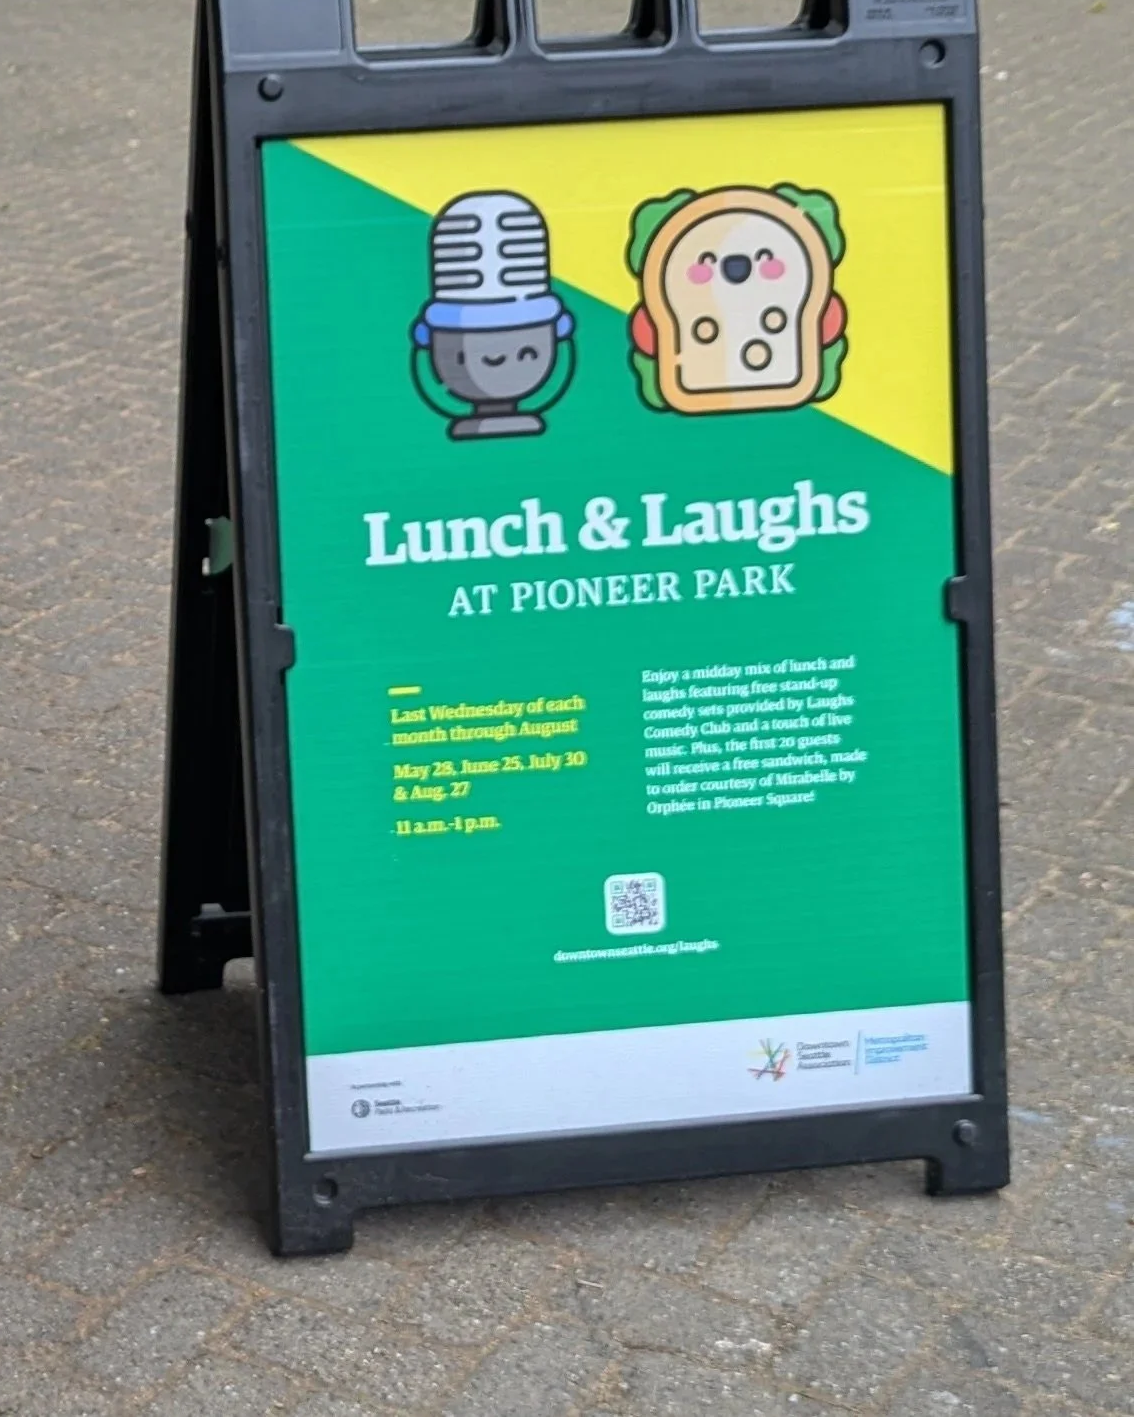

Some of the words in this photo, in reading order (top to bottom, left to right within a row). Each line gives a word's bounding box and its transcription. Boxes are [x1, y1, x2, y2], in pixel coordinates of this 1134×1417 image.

[363, 499, 567, 566] Lunch
[578, 496, 631, 551] &
[641, 479, 871, 553] Laughs
[448, 584, 499, 617] AT
[511, 572, 683, 613] PIONEER
[693, 562, 797, 600] PARK
[642, 669, 679, 685] Enjoy
[682, 671, 690, 680] a
[693, 664, 743, 680] midday
[744, 661, 771, 675] mix
[773, 659, 788, 674] of
[789, 656, 827, 672] lunch
[829, 655, 856, 670] and
[642, 688, 686, 703] laughs
[688, 682, 750, 698] featuring
[751, 679, 778, 694] free
[779, 676, 839, 691] stand-up
[391, 708, 427, 724] Last
[428, 699, 525, 721] Wednesday
[526, 697, 545, 714] of
[546, 694, 587, 712] each
[643, 705, 695, 722] comedy
[698, 703, 724, 716] sets
[726, 698, 785, 717] provided
[786, 697, 804, 712] by
[806, 693, 854, 710] Laughs
[392, 726, 448, 745] month
[449, 721, 516, 742] through
[518, 718, 578, 738] August
[644, 724, 698, 740] Comedy
[700, 720, 731, 736] Club
[733, 719, 758, 733] and
[761, 721, 769, 731] a
[771, 715, 810, 731] touch
[811, 713, 828, 727] of
[828, 711, 853, 726] live
[645, 743, 687, 758] music.
[691, 740, 722, 756] Plus,
[725, 738, 747, 752] the
[750, 736, 777, 750] first
[778, 736, 795, 749] 20
[797, 732, 841, 749] guests
[393, 764, 430, 781] May
[460, 759, 500, 774] June
[501, 755, 525, 771] 25,
[528, 752, 563, 771] July
[564, 751, 588, 766] 30
[645, 761, 671, 776] will
[673, 759, 720, 775] receive
[722, 760, 730, 771] a
[732, 755, 759, 770] free
[761, 750, 828, 768] sandwich,
[830, 748, 868, 763] made
[393, 786, 408, 801] &
[410, 785, 449, 802] Aug.
[450, 781, 471, 797] 27
[646, 783, 660, 795] to
[662, 779, 698, 795] order
[700, 775, 757, 792] courtesy
[759, 773, 775, 787] of
[776, 768, 837, 785] Mirabelle
[838, 768, 856, 782] by
[698, 797, 711, 810] in
[713, 793, 763, 808] Pioneer
[765, 790, 815, 806] Square!
[396, 820, 411, 836] 11
[464, 816, 502, 833] p.m.
